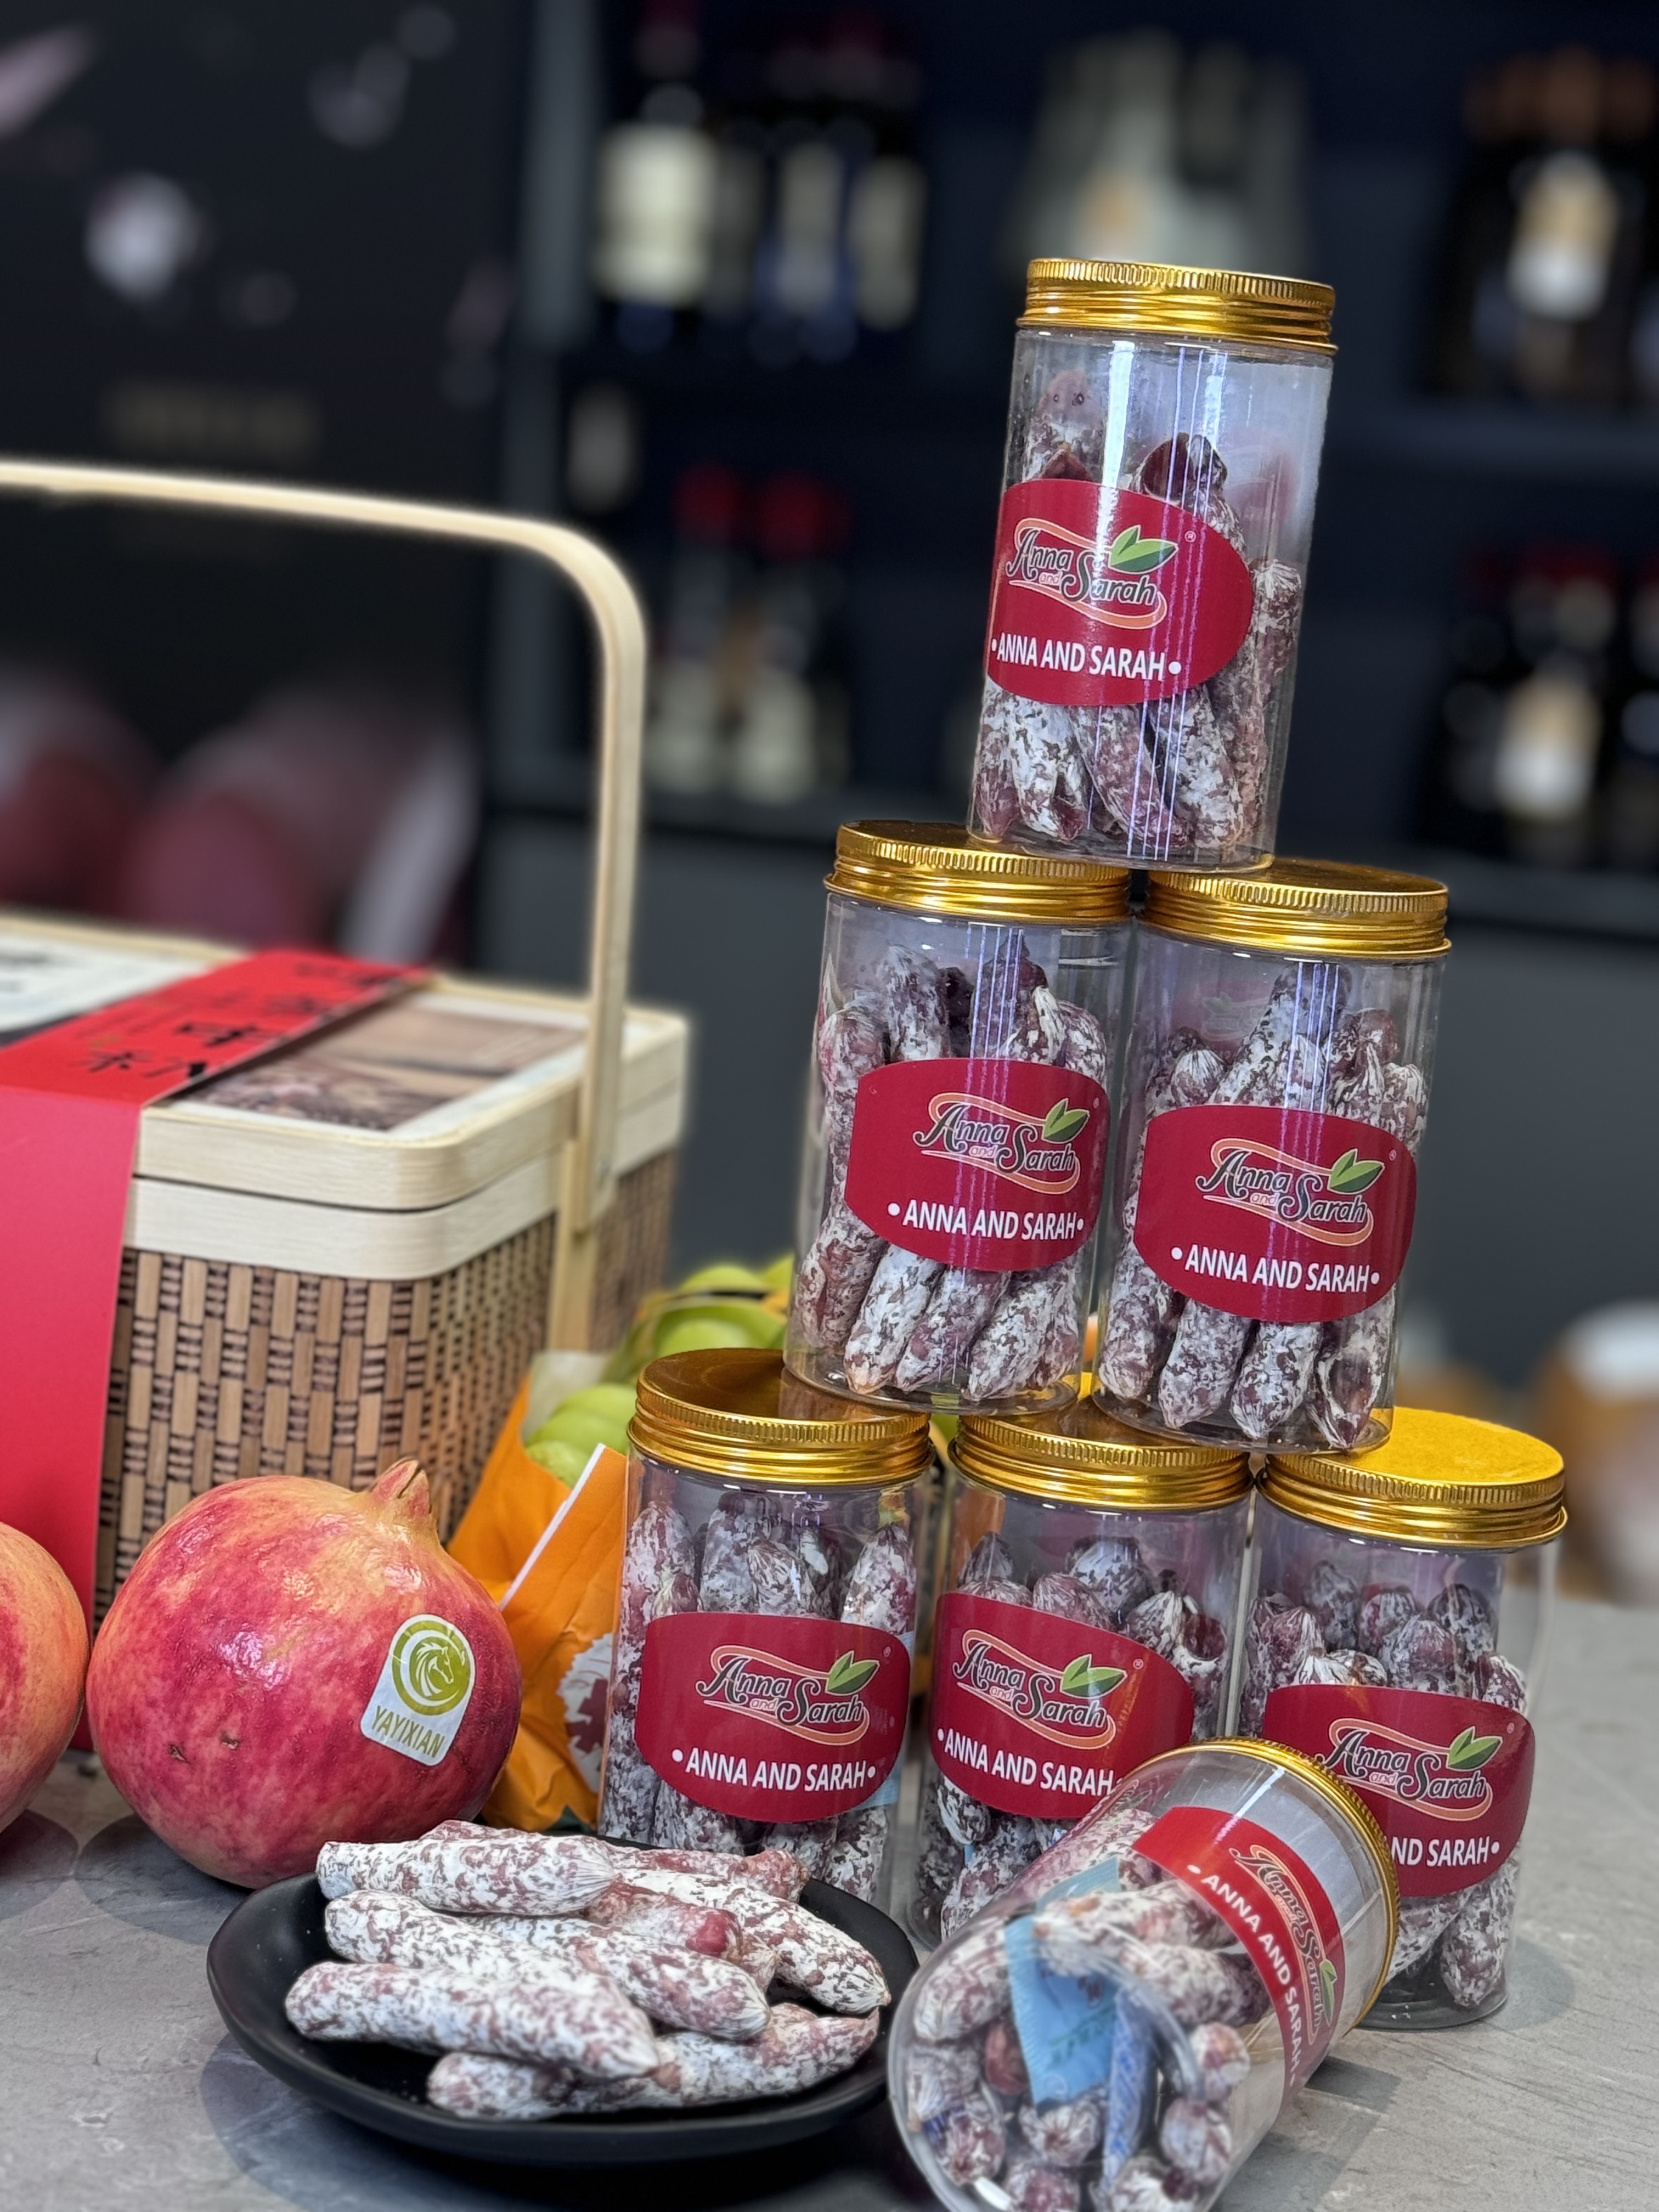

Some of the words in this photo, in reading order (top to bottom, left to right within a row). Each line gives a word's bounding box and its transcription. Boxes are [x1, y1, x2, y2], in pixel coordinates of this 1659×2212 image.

[1006, 530, 1072, 582] Anna
[1059, 552, 1157, 605] Sarah
[997, 633, 1037, 668] ANNA
[1042, 639, 1086, 672] AND
[1089, 646, 1166, 681] SARAH
[913, 1103, 1009, 1153] Anna
[995, 1125, 1075, 1173] Sarah
[902, 1200, 967, 1234] ANNA
[971, 1209, 1019, 1239] AND
[1022, 1212, 1077, 1240] SARAH
[1195, 1150, 1293, 1200] Anna
[1277, 1175, 1368, 1223] Sarah
[1184, 1244, 1248, 1283] ANNA
[1252, 1258, 1302, 1289] AND
[1305, 1263, 1369, 1293] SARAH
[696, 1655, 792, 1705] Anna
[776, 1678, 864, 1726] Sarah
[953, 1643, 1025, 1691] Anna
[1011, 1673, 1107, 1729] Sarah
[371, 1705, 445, 1758] YAYIXIAN
[944, 1729, 988, 1773] ANNA
[991, 1750, 1037, 1785] AND
[1040, 1762, 1114, 1796] SARAH
[1317, 1730, 1412, 1778] Anna
[1396, 1753, 1486, 1801] Sarah
[685, 1748, 747, 1786] ANNA
[752, 1760, 801, 1791] AND
[804, 1760, 866, 1792] SARAH
[1390, 1836, 1423, 1865] ND
[1426, 1836, 1490, 1867] SARAH
[1200, 1874, 1261, 1933] ANNA
[1259, 1933, 1290, 1985] AND
[1284, 1985, 1304, 2072] SARAH
